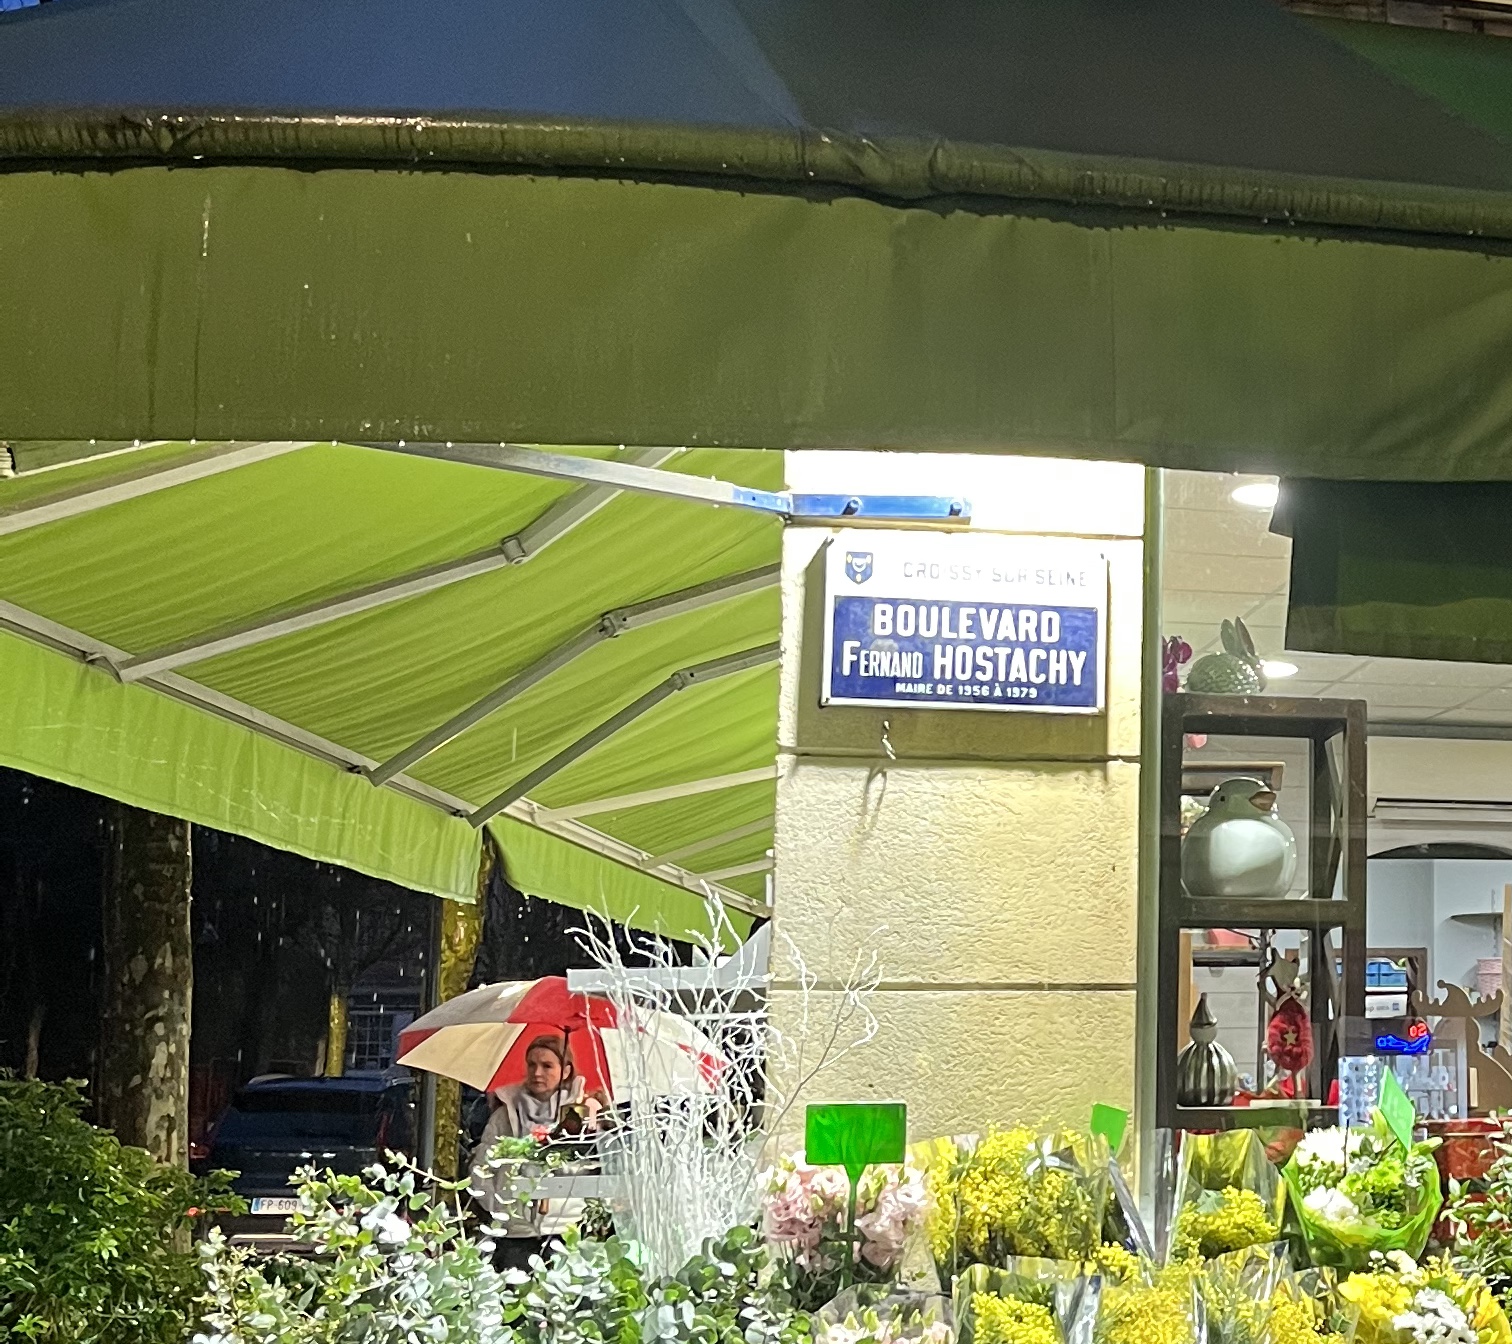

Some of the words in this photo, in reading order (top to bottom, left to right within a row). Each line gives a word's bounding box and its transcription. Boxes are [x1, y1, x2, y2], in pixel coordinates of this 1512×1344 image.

[873, 602, 1061, 644] BOULEVARD
[933, 644, 1087, 686] HOSTACHY
[895, 682, 933, 695] MAIRE
[936, 684, 953, 696] DE
[1006, 686, 1038, 699] 1979
